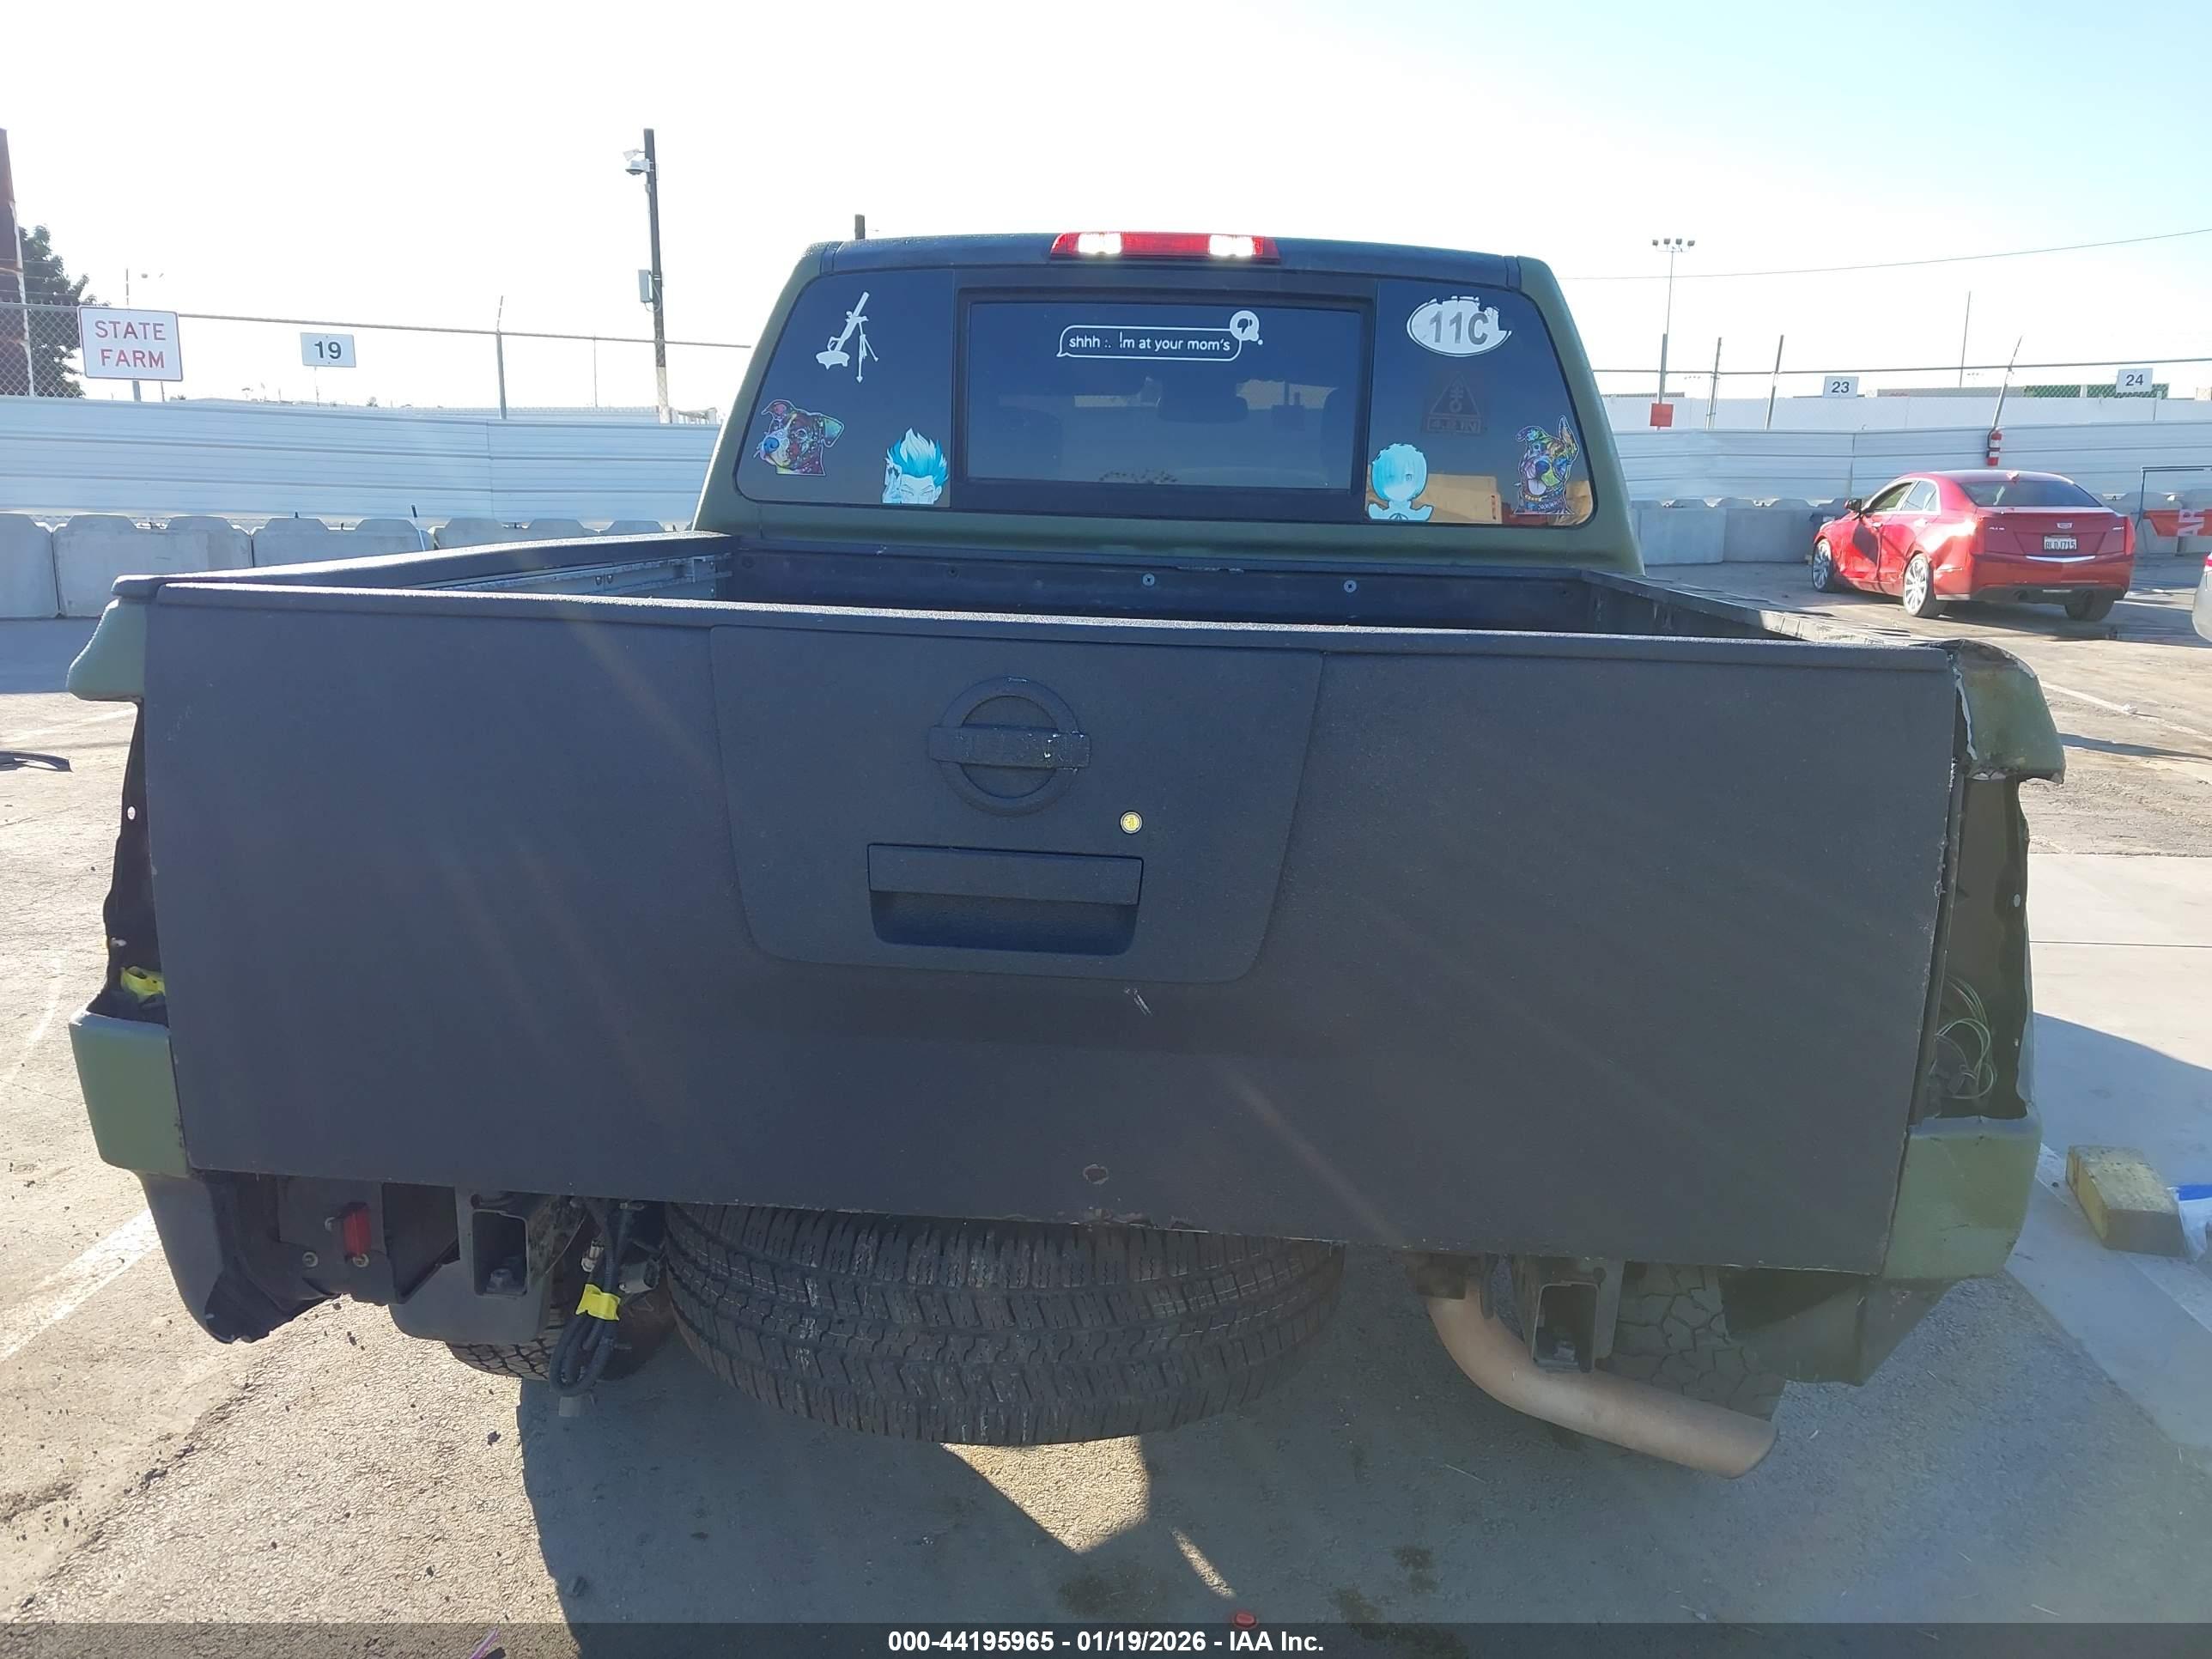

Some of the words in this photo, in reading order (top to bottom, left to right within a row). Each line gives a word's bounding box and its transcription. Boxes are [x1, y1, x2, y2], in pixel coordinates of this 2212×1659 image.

[94, 320, 166, 340] STATE
[1430, 311, 1489, 345] 11C
[314, 341, 341, 359] 19
[1069, 335, 1100, 348] shhh
[1139, 337, 1151, 349] at
[1154, 338, 1183, 352] your
[1187, 337, 1231, 351] mom's
[100, 349, 165, 368] FARM
[1832, 380, 1850, 393] 23
[2125, 374, 2143, 386] 24
